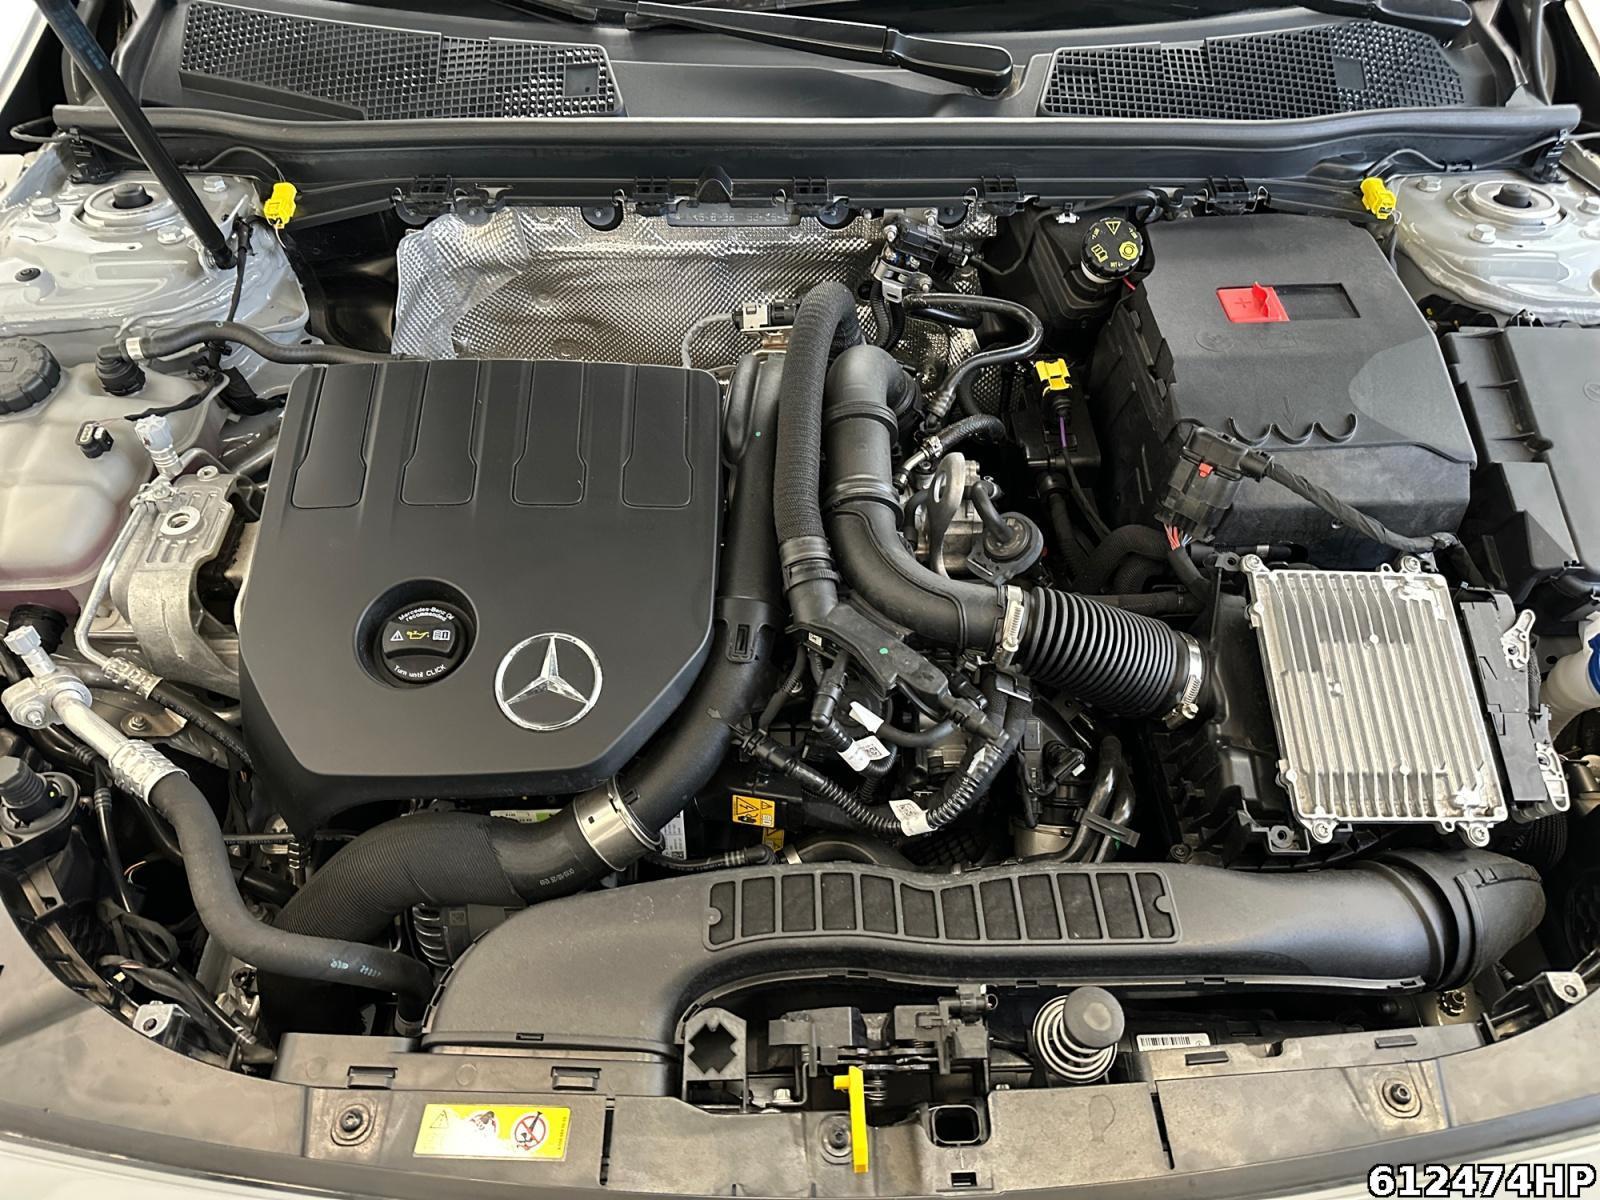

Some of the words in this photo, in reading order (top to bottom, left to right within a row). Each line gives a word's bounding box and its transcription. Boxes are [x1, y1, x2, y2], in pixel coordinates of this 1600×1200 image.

[398, 607, 446, 621] Mercedes-Benz
[405, 612, 447, 621] recommended
[394, 665, 408, 676] Turn
[426, 664, 446, 677] CLICK
